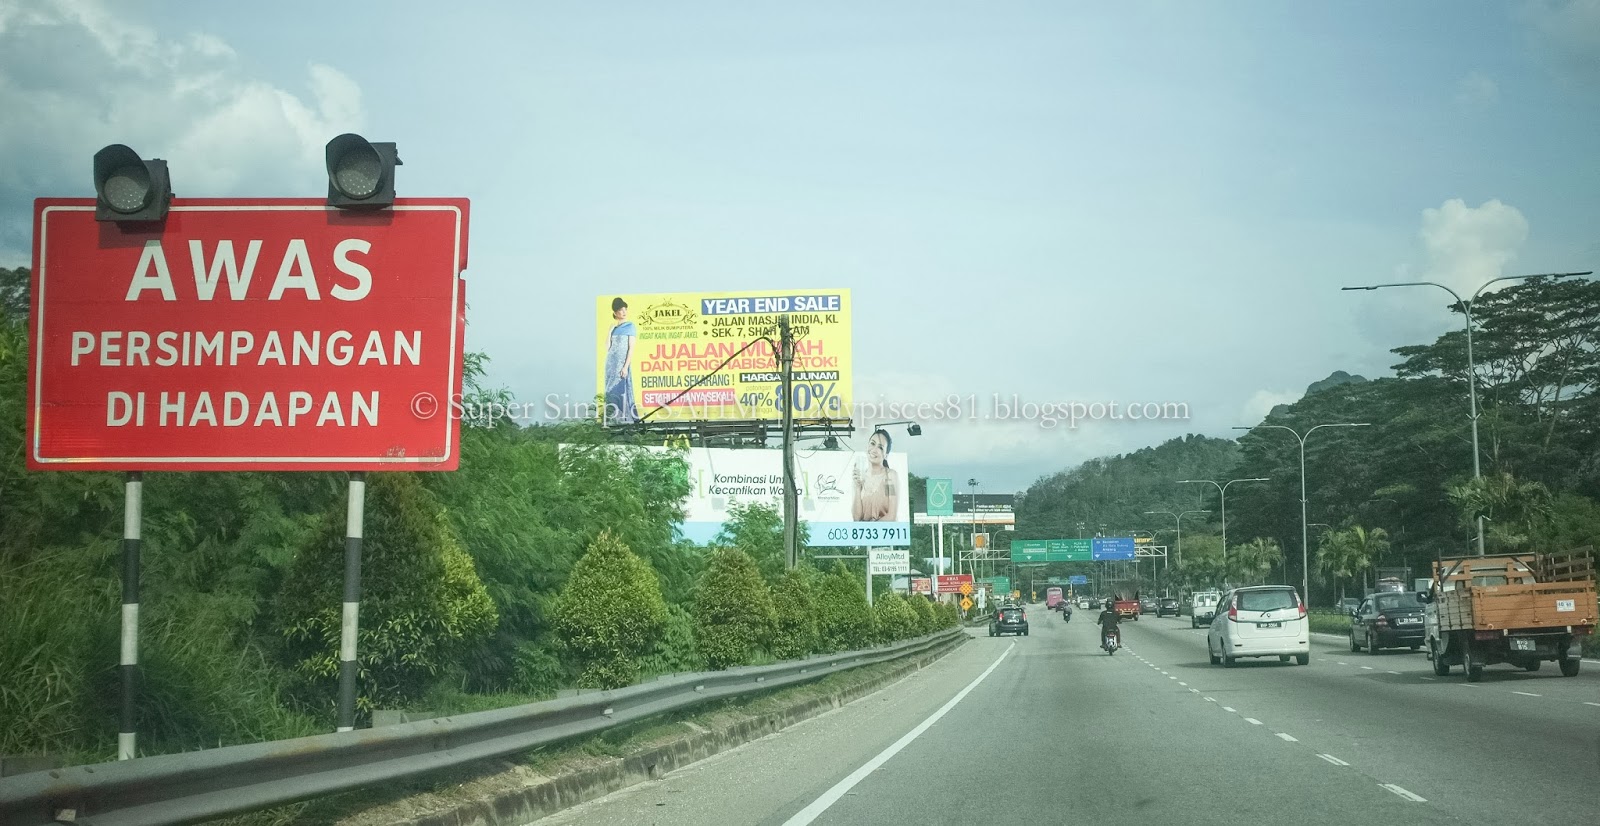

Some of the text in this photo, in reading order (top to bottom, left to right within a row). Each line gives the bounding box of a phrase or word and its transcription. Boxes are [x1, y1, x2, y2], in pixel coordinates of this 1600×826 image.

[125, 239, 373, 302] AWAS
[704, 296, 839, 314] YEAR END SALE
[654, 309, 682, 318] JAKEL
[711, 314, 839, 327] JALAN MASJI INDIA, KL
[711, 328, 735, 338] SEK.
[737, 327, 746, 338] 7,
[71, 330, 422, 367] PERSIMPANGAN
[649, 342, 734, 360] JUALAN
[641, 361, 673, 372] DAN
[792, 357, 837, 368] STOK!
[641, 375, 682, 388] BERMULA
[684, 374, 730, 388] SEKARANG
[741, 373, 782, 382] HARGA
[797, 372, 837, 381] JUNAM
[740, 392, 773, 407] 40%
[106, 391, 380, 427] DI HADAPAN
[714, 474, 767, 484] Kombinasi
[709, 485, 803, 495] Kecantikan Waa
[828, 528, 907, 540] 603 8733 7911
[876, 553, 905, 561] AlloyMtd
